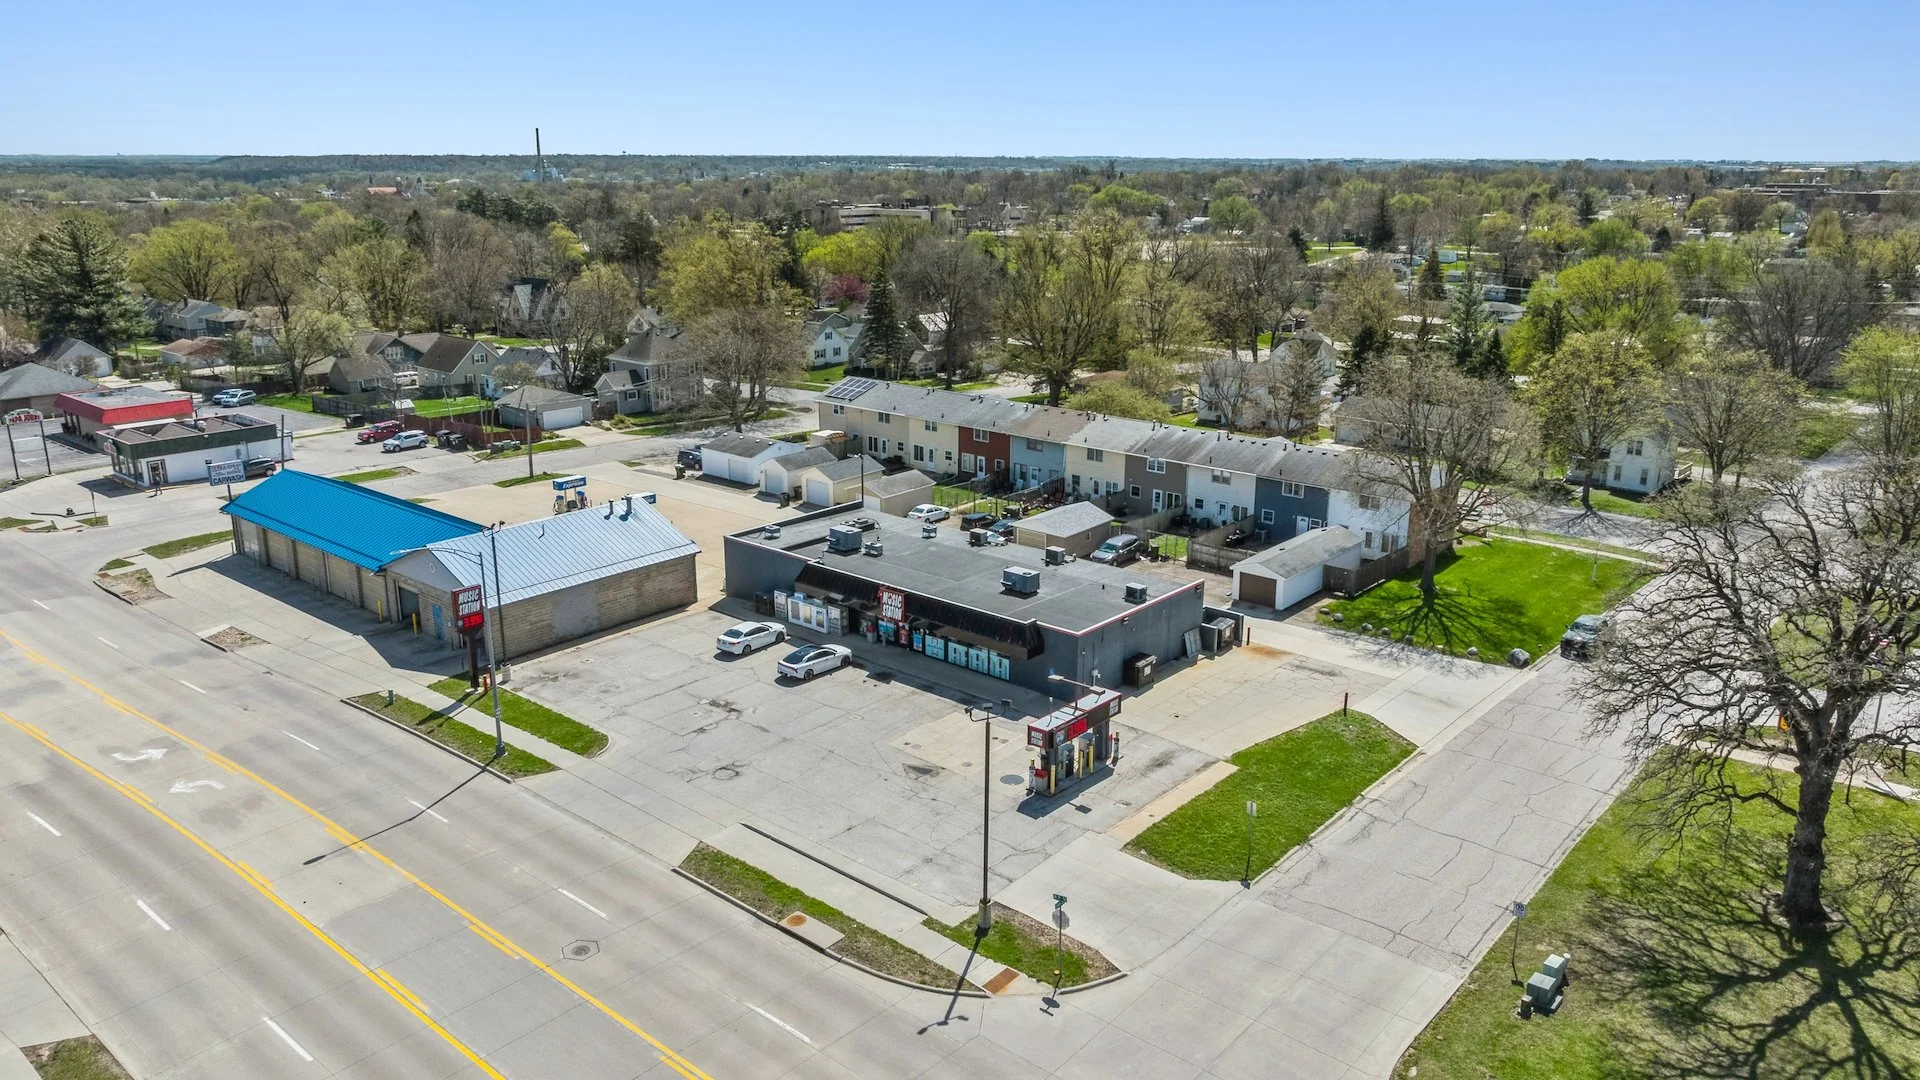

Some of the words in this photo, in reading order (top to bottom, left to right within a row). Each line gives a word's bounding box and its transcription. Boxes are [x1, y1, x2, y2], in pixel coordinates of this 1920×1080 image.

[458, 588, 479, 605] MUSIC
[882, 591, 902, 608] MUSIC
[459, 599, 481, 616] STATION
[882, 604, 902, 621] STATION
